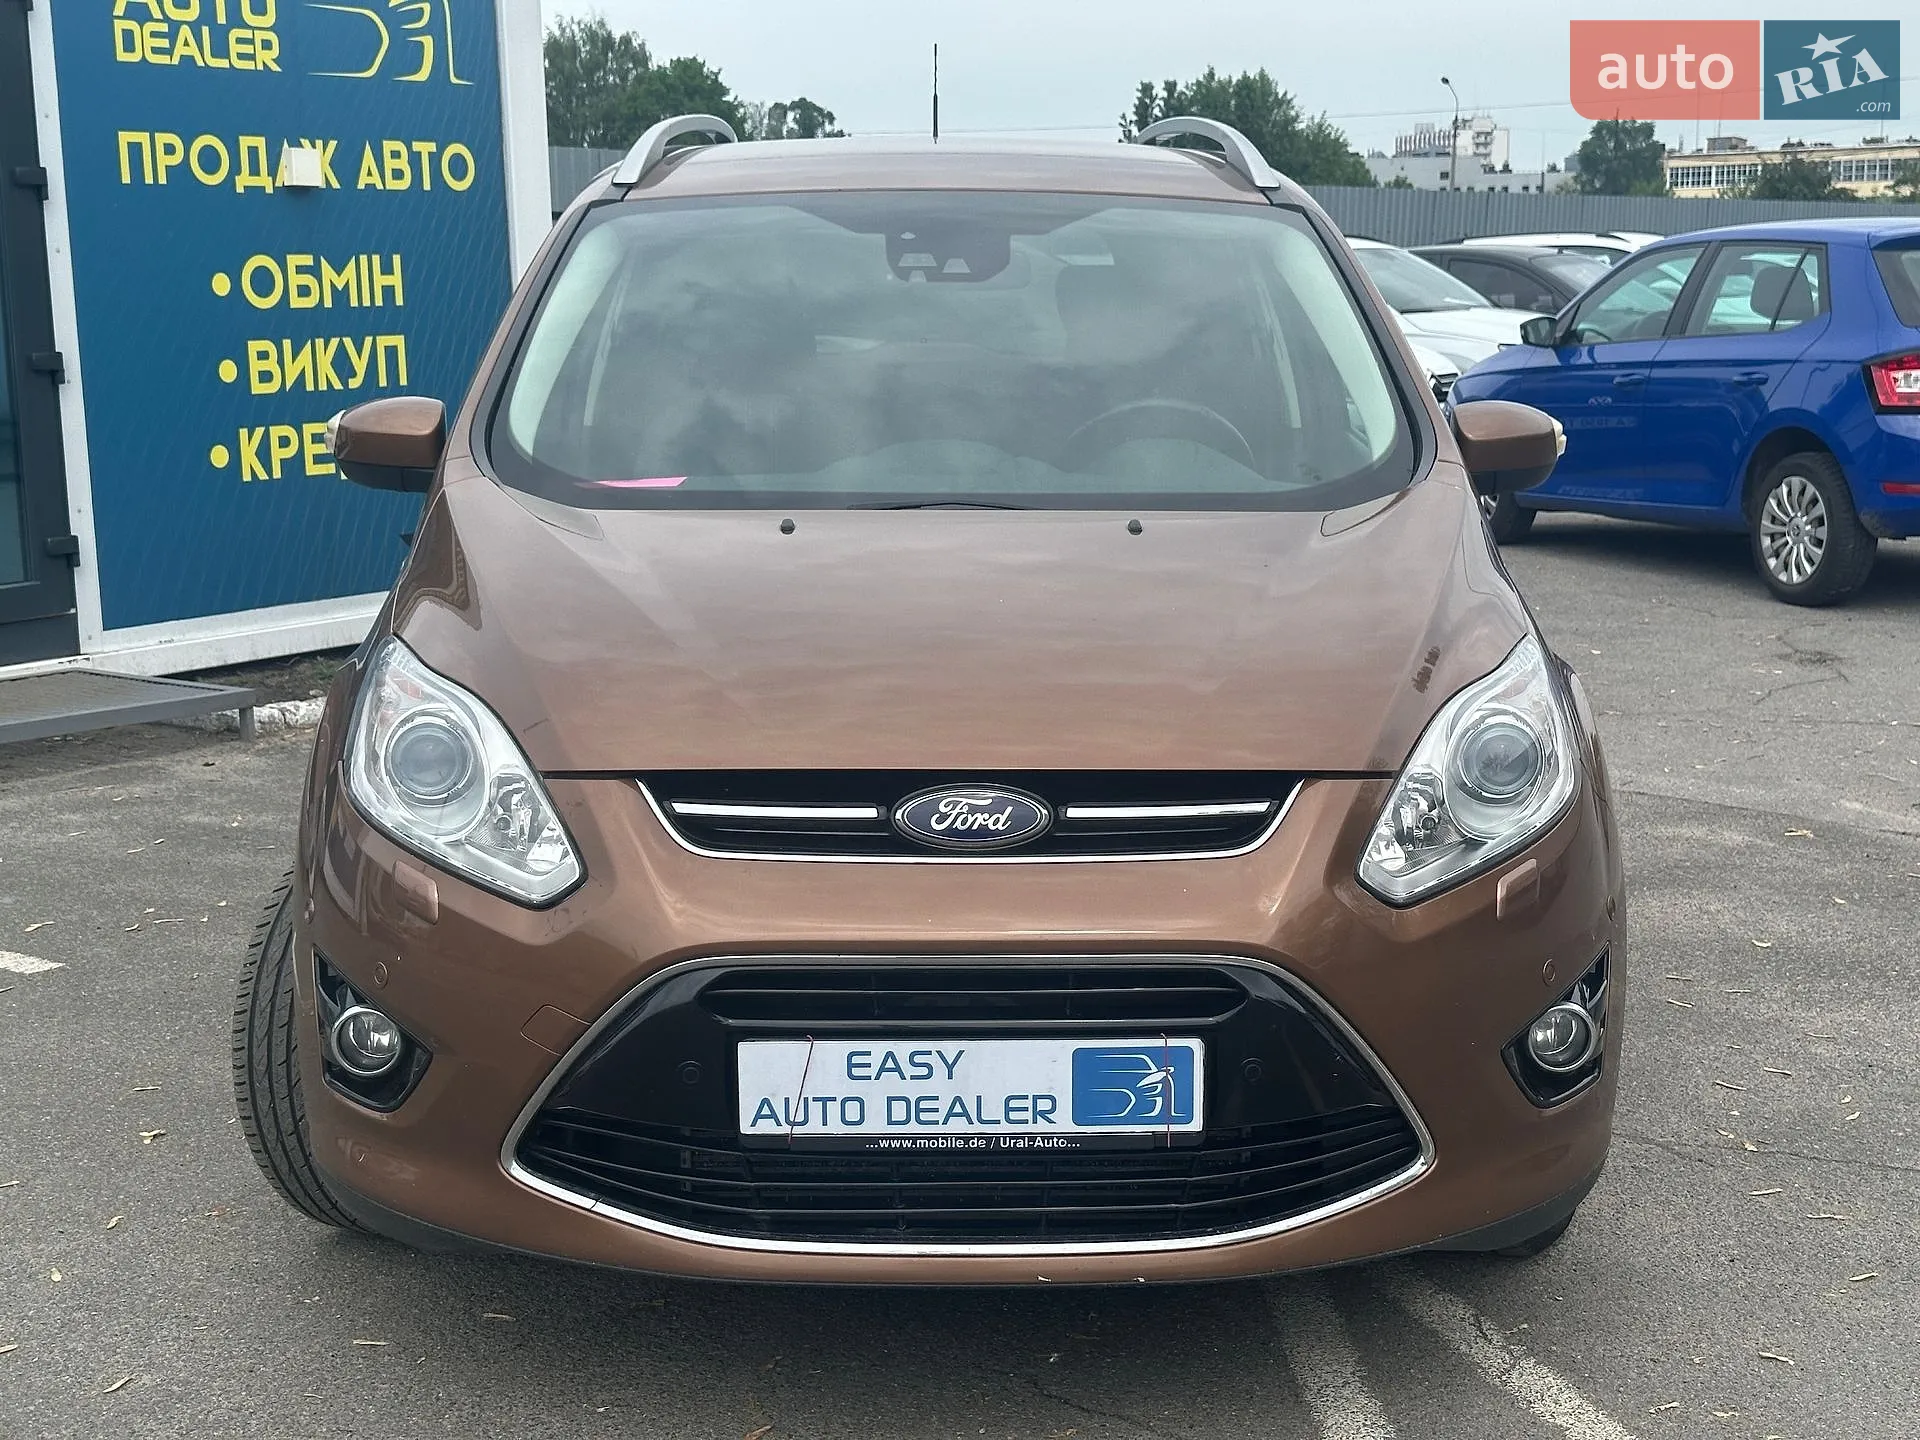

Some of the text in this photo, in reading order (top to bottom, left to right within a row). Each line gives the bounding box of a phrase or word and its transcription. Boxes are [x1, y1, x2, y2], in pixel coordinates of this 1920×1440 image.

[113, 19, 282, 72] DEALER
[357, 140, 476, 192] АВТО
[241, 254, 404, 310] ОБМІН
[247, 334, 408, 395] ВИКУП
[239, 421, 348, 482] КРЕ
[930, 797, 1013, 831] Ford
[845, 1049, 965, 1081] EASY
[750, 1094, 1058, 1128] AUTO DEALER
